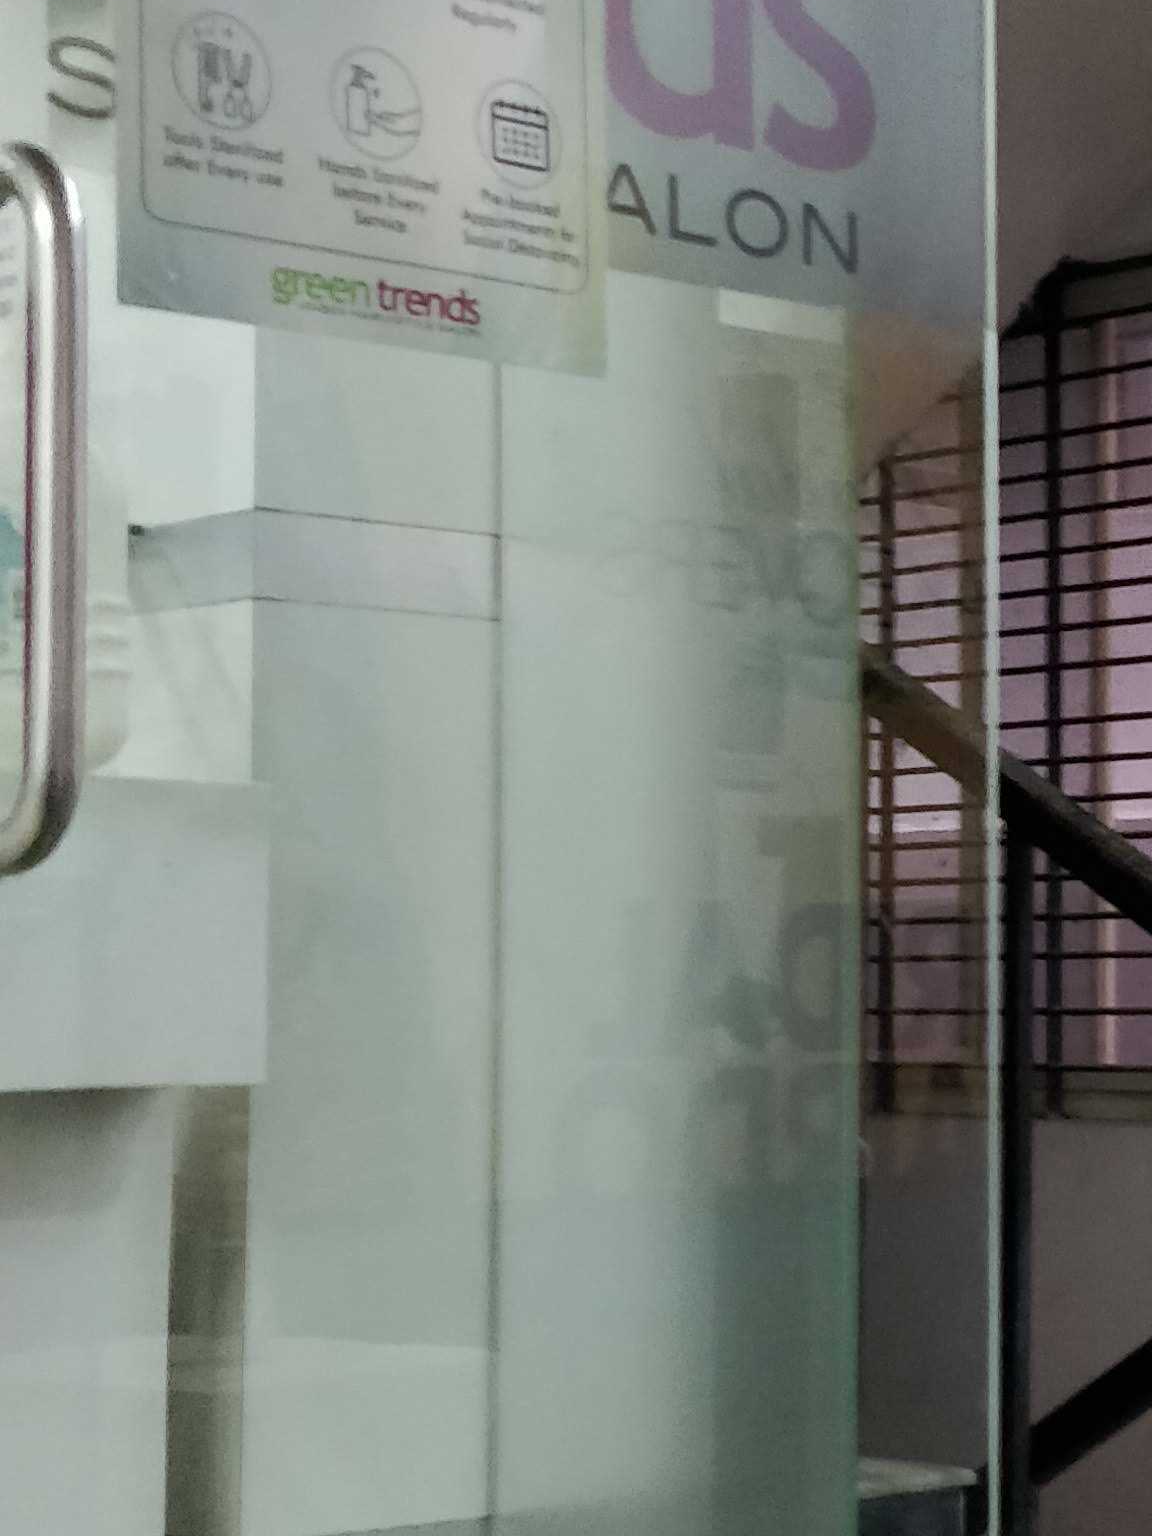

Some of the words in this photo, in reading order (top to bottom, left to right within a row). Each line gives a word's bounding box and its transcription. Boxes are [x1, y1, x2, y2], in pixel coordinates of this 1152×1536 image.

[606, 162, 860, 275] ALON
[272, 267, 371, 307] green
[375, 278, 480, 326] trends
